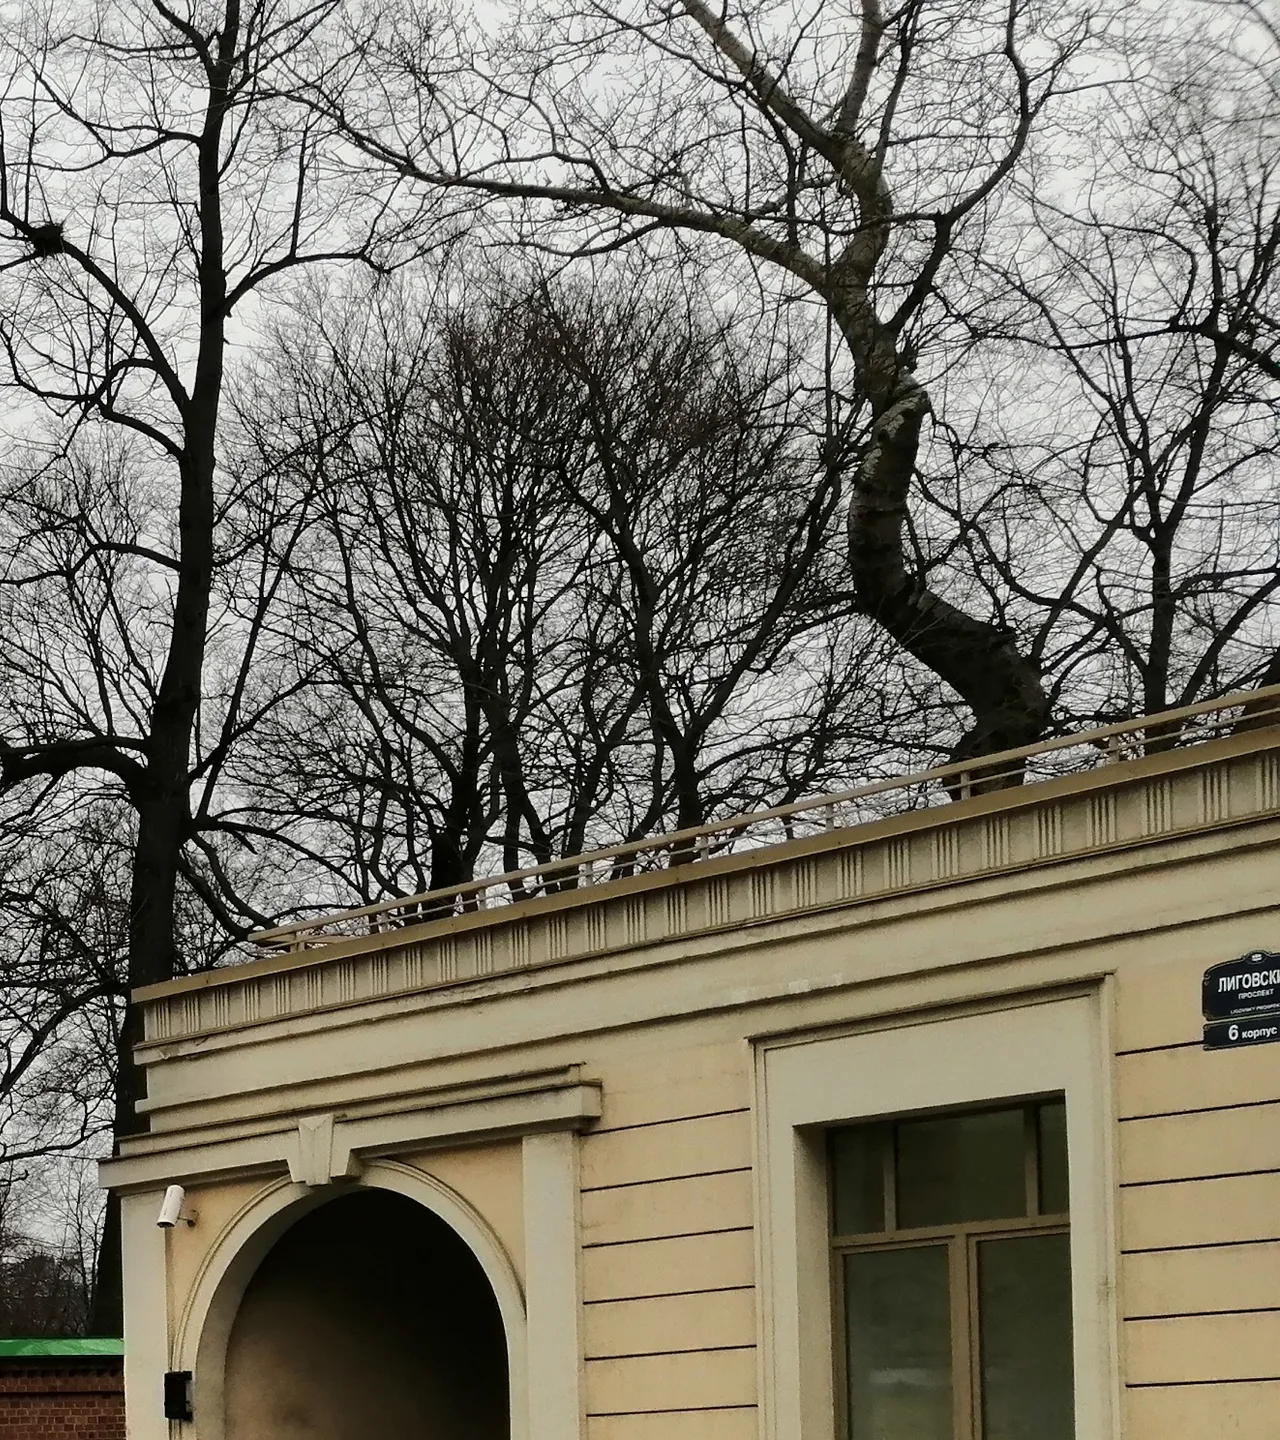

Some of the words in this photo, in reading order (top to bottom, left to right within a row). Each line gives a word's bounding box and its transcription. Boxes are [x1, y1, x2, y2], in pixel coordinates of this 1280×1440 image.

[1237, 988, 1275, 1000] ПРОСПЕКТ
[1228, 1024, 1239, 1041] 6
[1241, 1026, 1278, 1040] корпус
